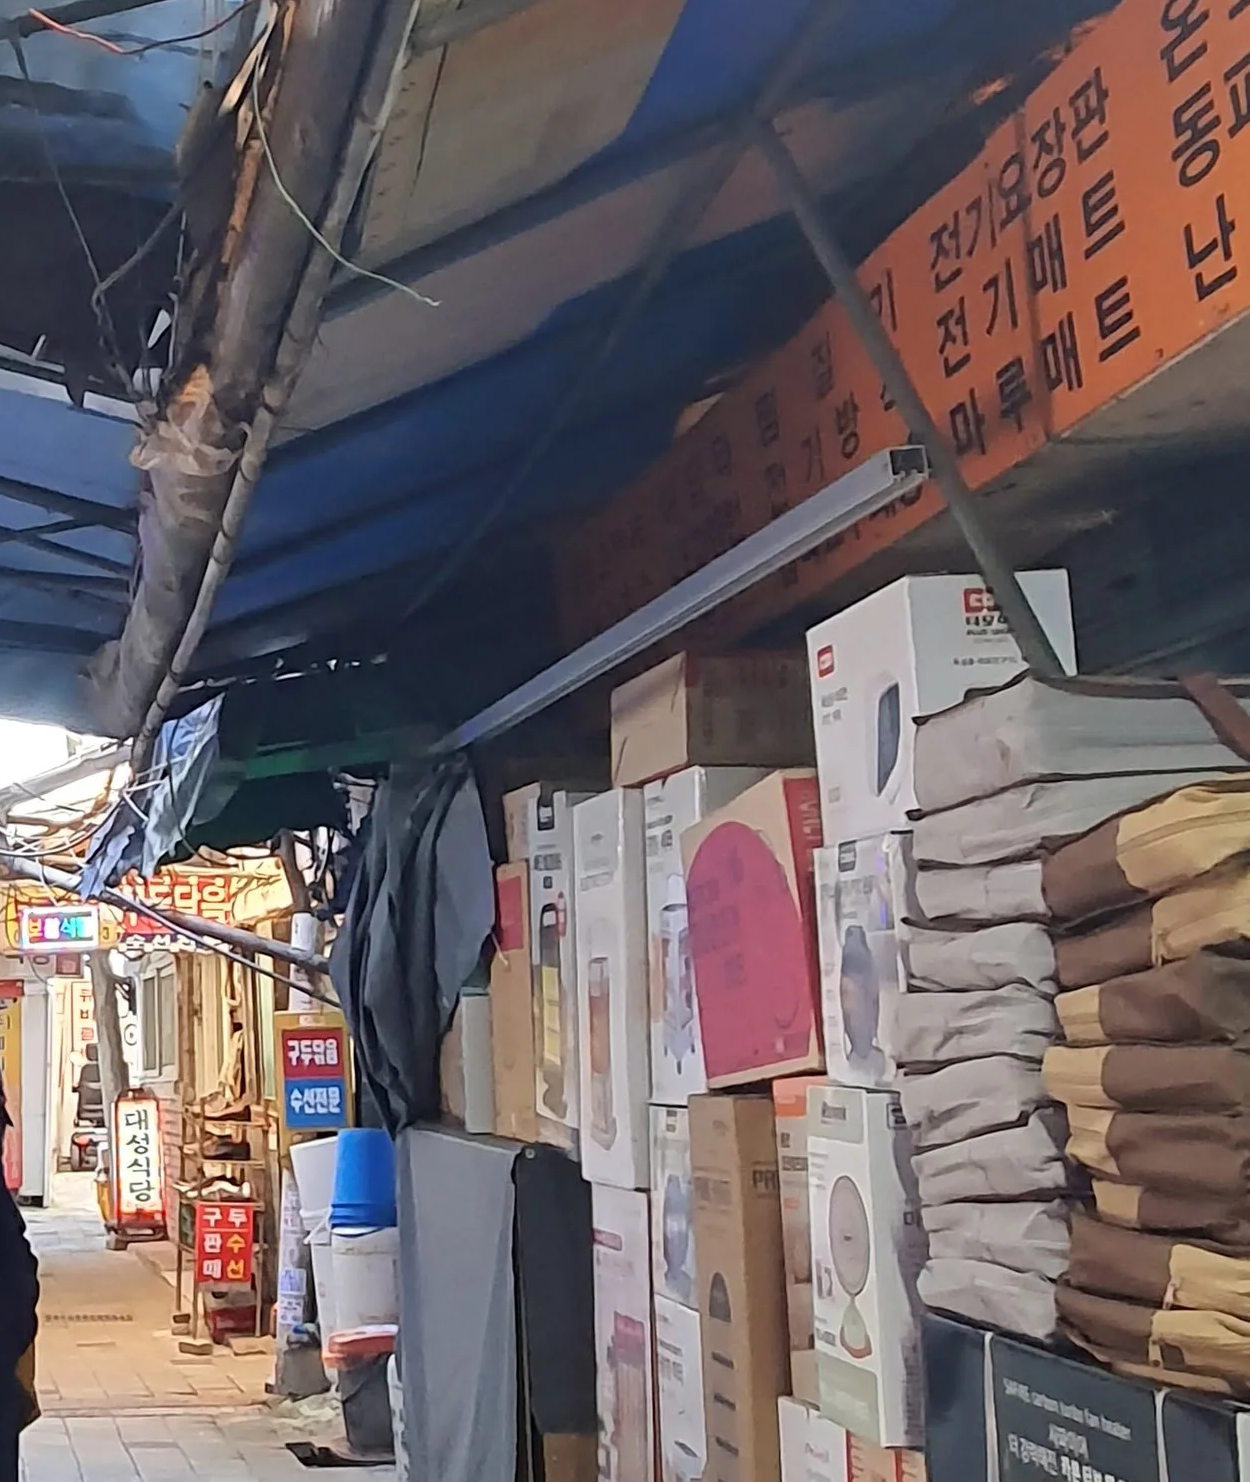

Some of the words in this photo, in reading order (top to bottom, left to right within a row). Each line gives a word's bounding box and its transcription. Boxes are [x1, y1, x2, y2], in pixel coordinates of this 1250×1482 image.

[930, 67, 1109, 293] 전기요장판
[936, 169, 1126, 379] 전기매트
[949, 276, 1141, 455] 마루매트
[124, 1109, 156, 1203] 대성식당
[202, 1207, 248, 1228] 구두
